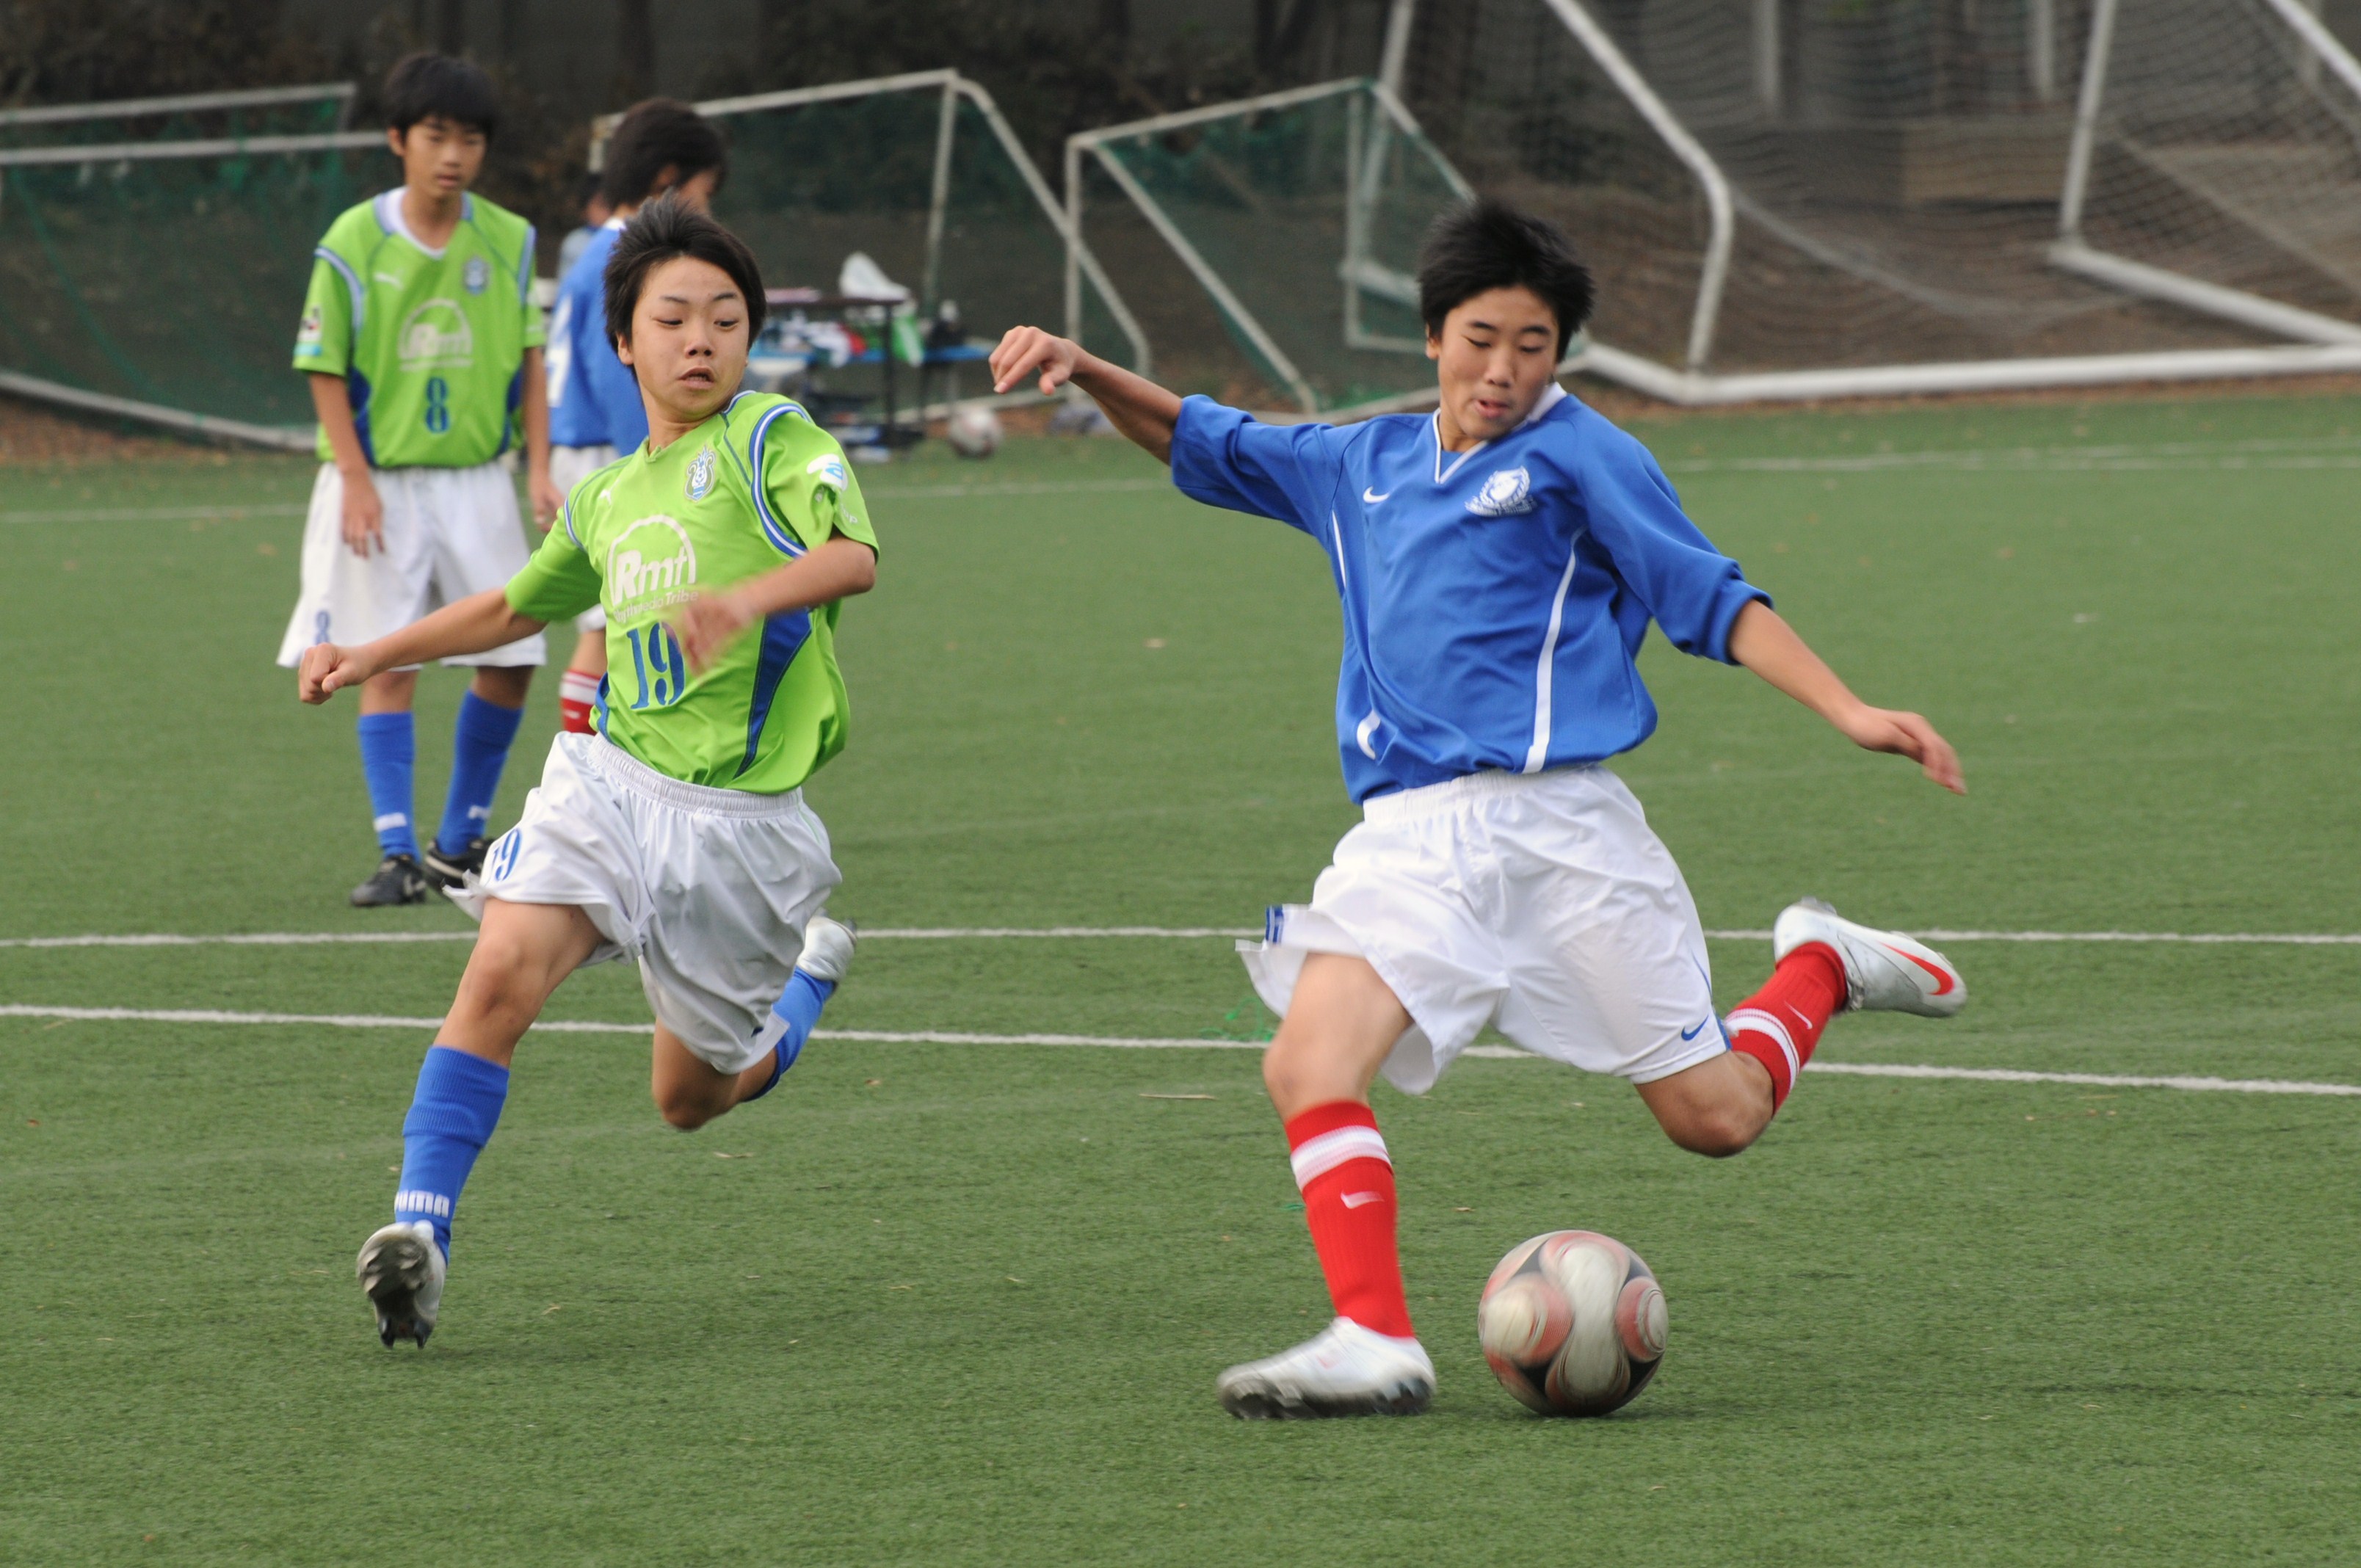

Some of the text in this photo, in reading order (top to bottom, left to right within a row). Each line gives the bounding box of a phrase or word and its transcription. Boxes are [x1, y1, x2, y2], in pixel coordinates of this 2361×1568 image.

[425, 375, 451, 433] 8
[664, 587, 699, 609] Tribe
[626, 622, 684, 709] 19
